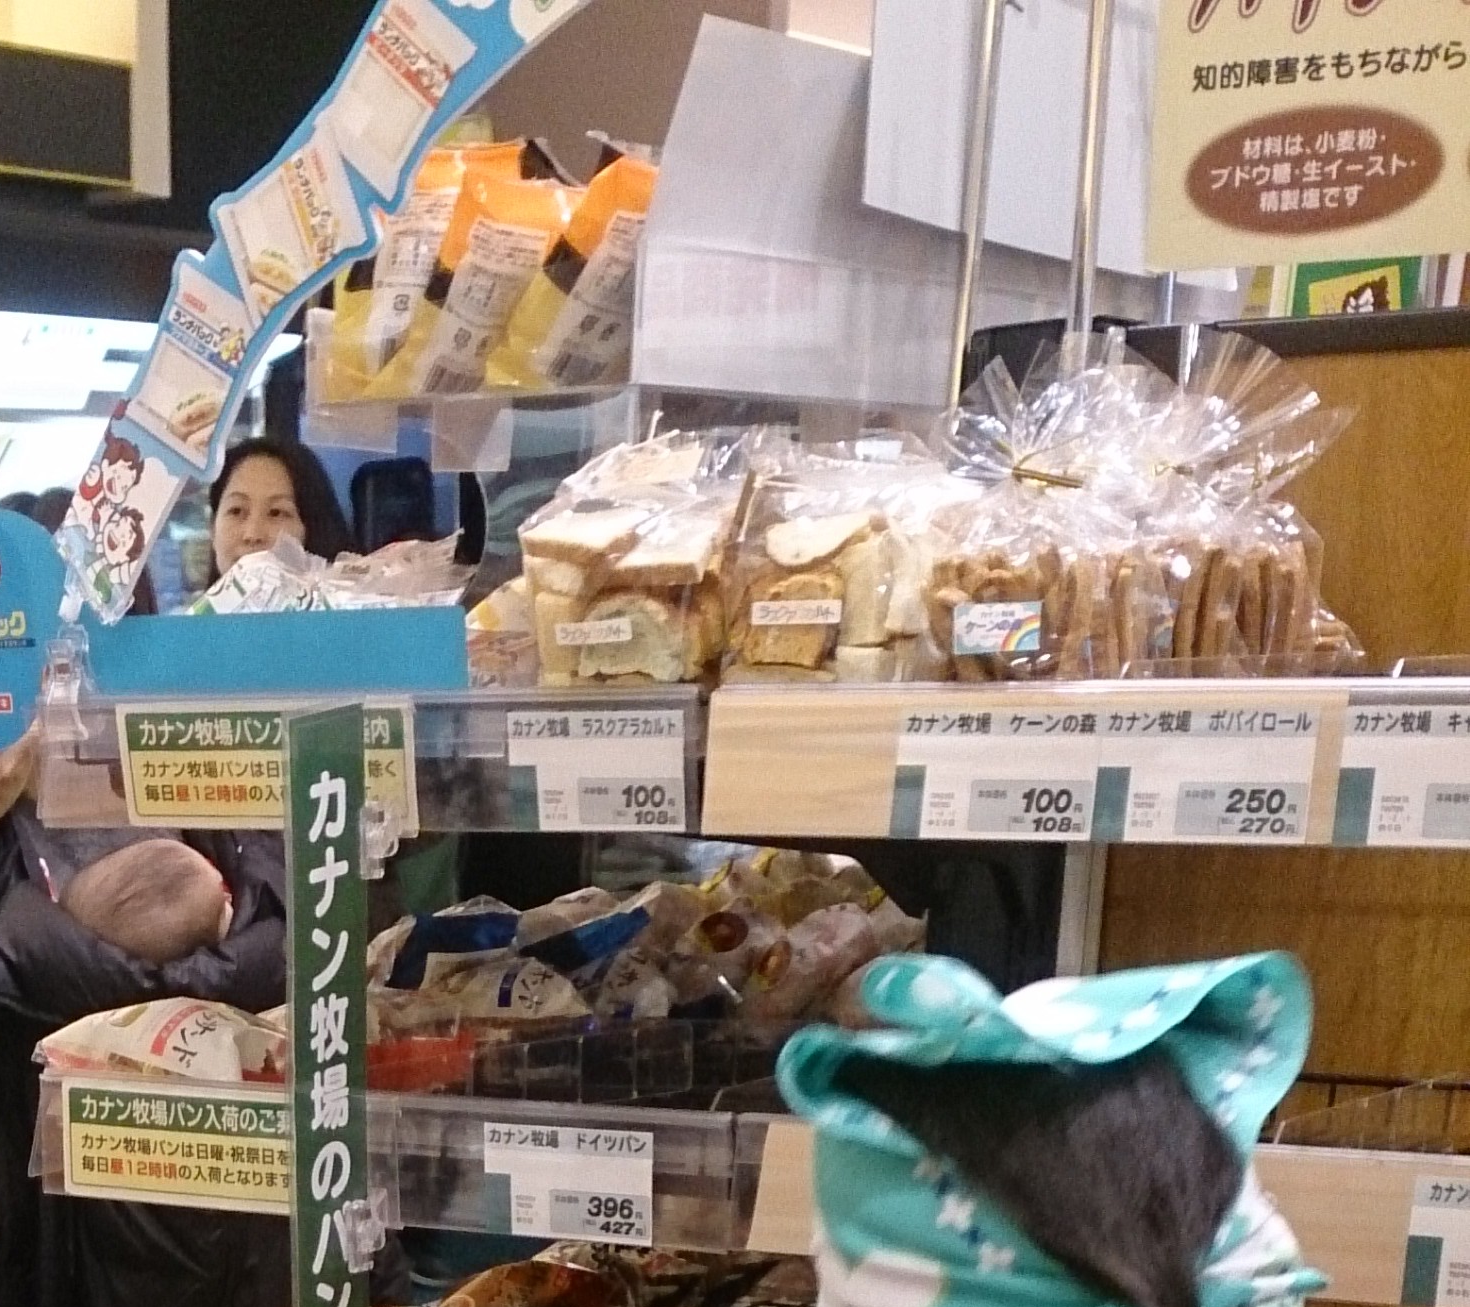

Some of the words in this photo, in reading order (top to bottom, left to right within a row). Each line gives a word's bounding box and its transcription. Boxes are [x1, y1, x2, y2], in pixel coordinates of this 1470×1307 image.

[1192, 40, 1468, 93] 知的障害をもちながら
[1259, 184, 1364, 213] 精製塩です
[513, 716, 570, 738] カナン牧場
[582, 716, 677, 736] ラスクアラカルト
[907, 712, 992, 734] カナン牧場
[1010, 712, 1097, 734] ケーンの森
[1108, 710, 1192, 733] カナン牧場
[1354, 711, 1432, 733] カナン牧場
[144, 783, 283, 803] 毎日昼12時頃の入
[488, 1128, 559, 1149] カナン牧場
[576, 1132, 647, 1153] ドイツパン
